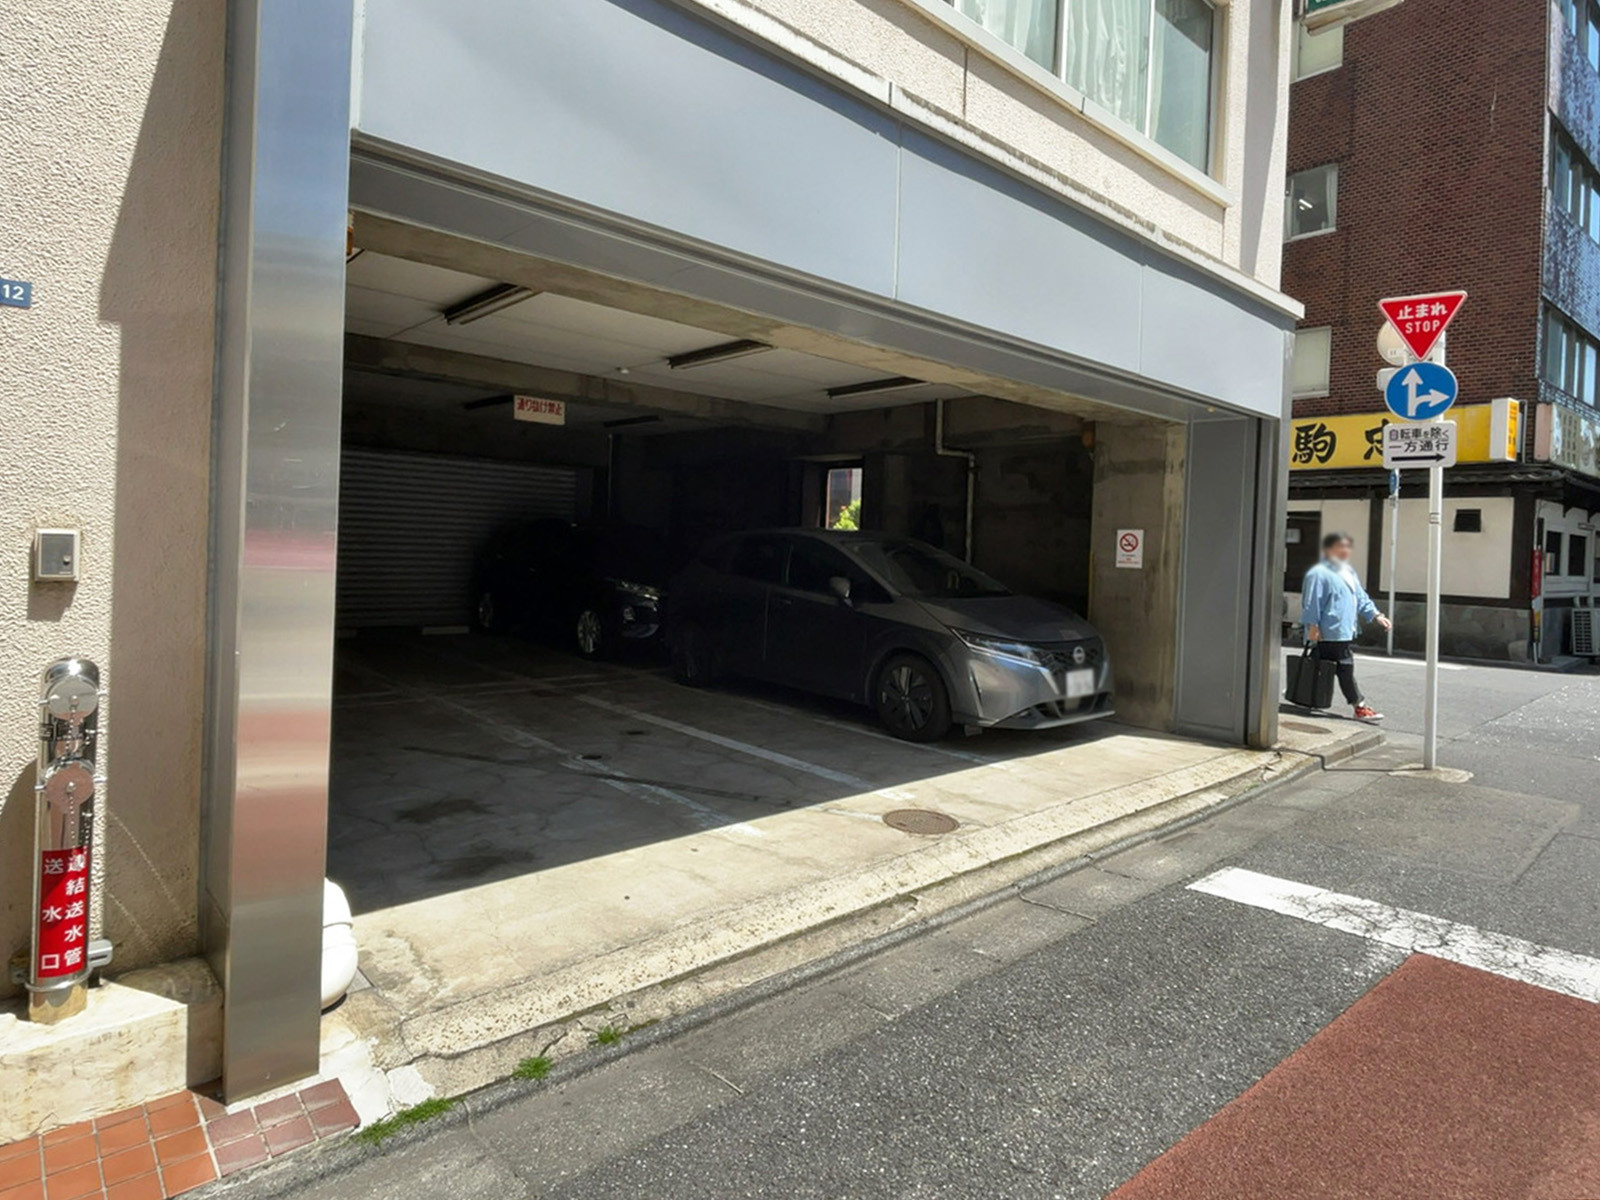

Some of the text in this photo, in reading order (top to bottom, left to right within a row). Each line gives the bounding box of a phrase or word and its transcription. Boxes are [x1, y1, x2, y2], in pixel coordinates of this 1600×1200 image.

[3, 284, 25, 301] 12
[1396, 302, 1447, 320] 止まれ
[1405, 320, 1440, 334] STOP
[1389, 427, 1449, 441] 自転車を除く
[1389, 440, 1449, 453] 一方通行
[41, 858, 64, 970] 送水口
